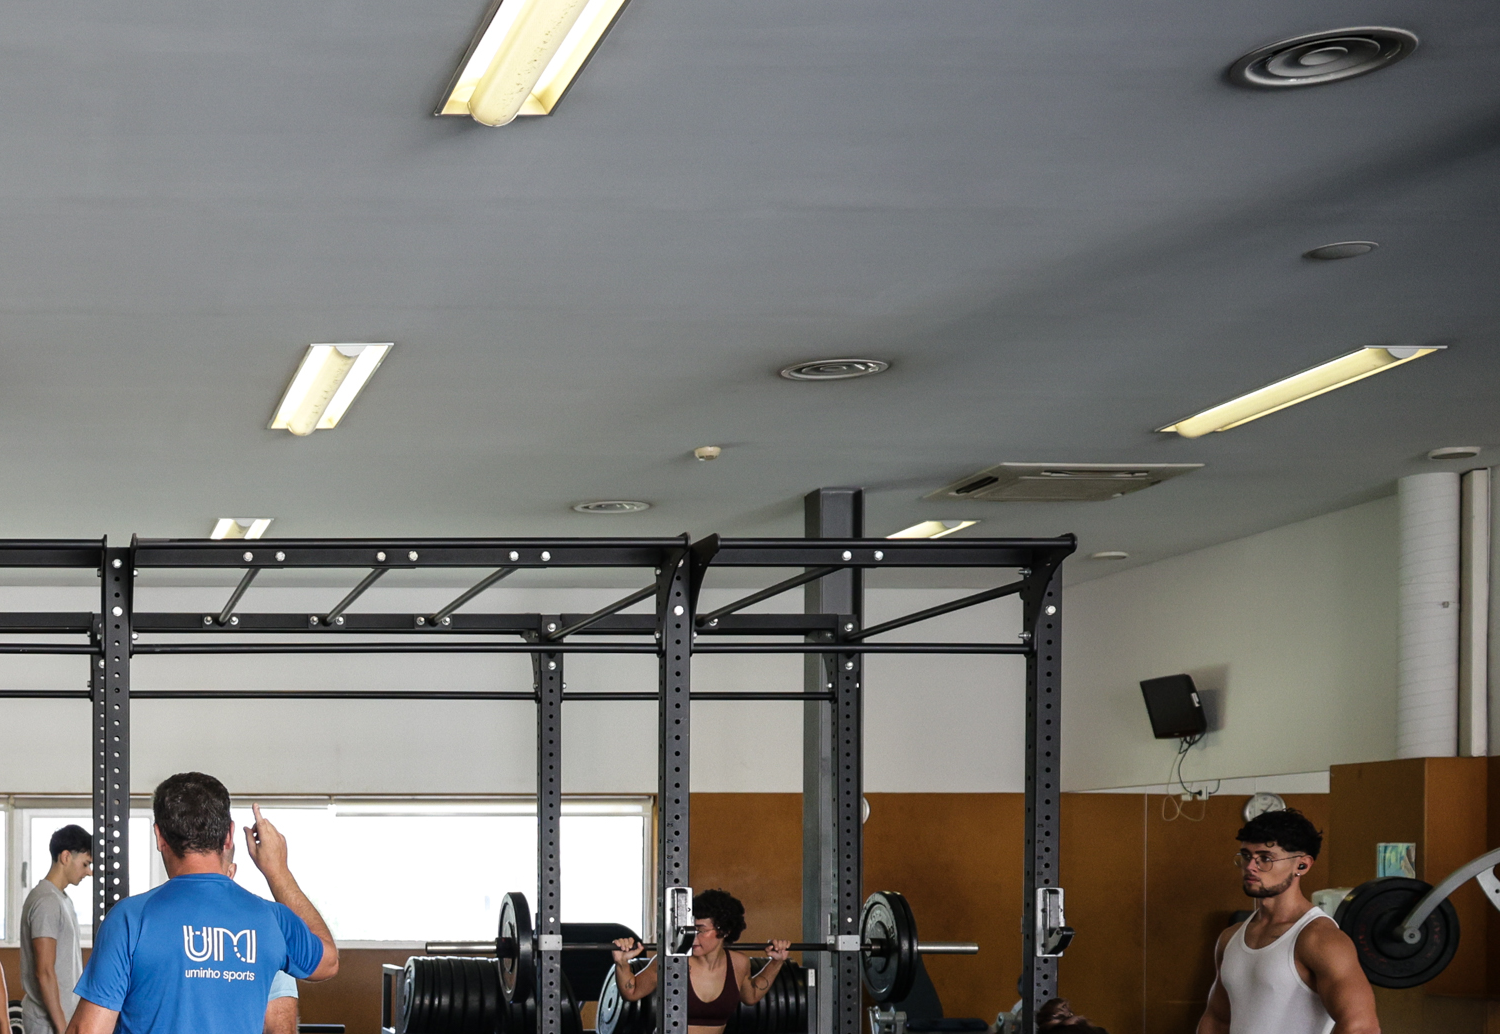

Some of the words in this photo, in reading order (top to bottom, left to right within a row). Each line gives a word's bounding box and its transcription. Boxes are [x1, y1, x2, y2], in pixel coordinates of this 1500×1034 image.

[182, 925, 256, 964] UM
[185, 968, 220, 978] uminho
[223, 970, 255, 982] sports
